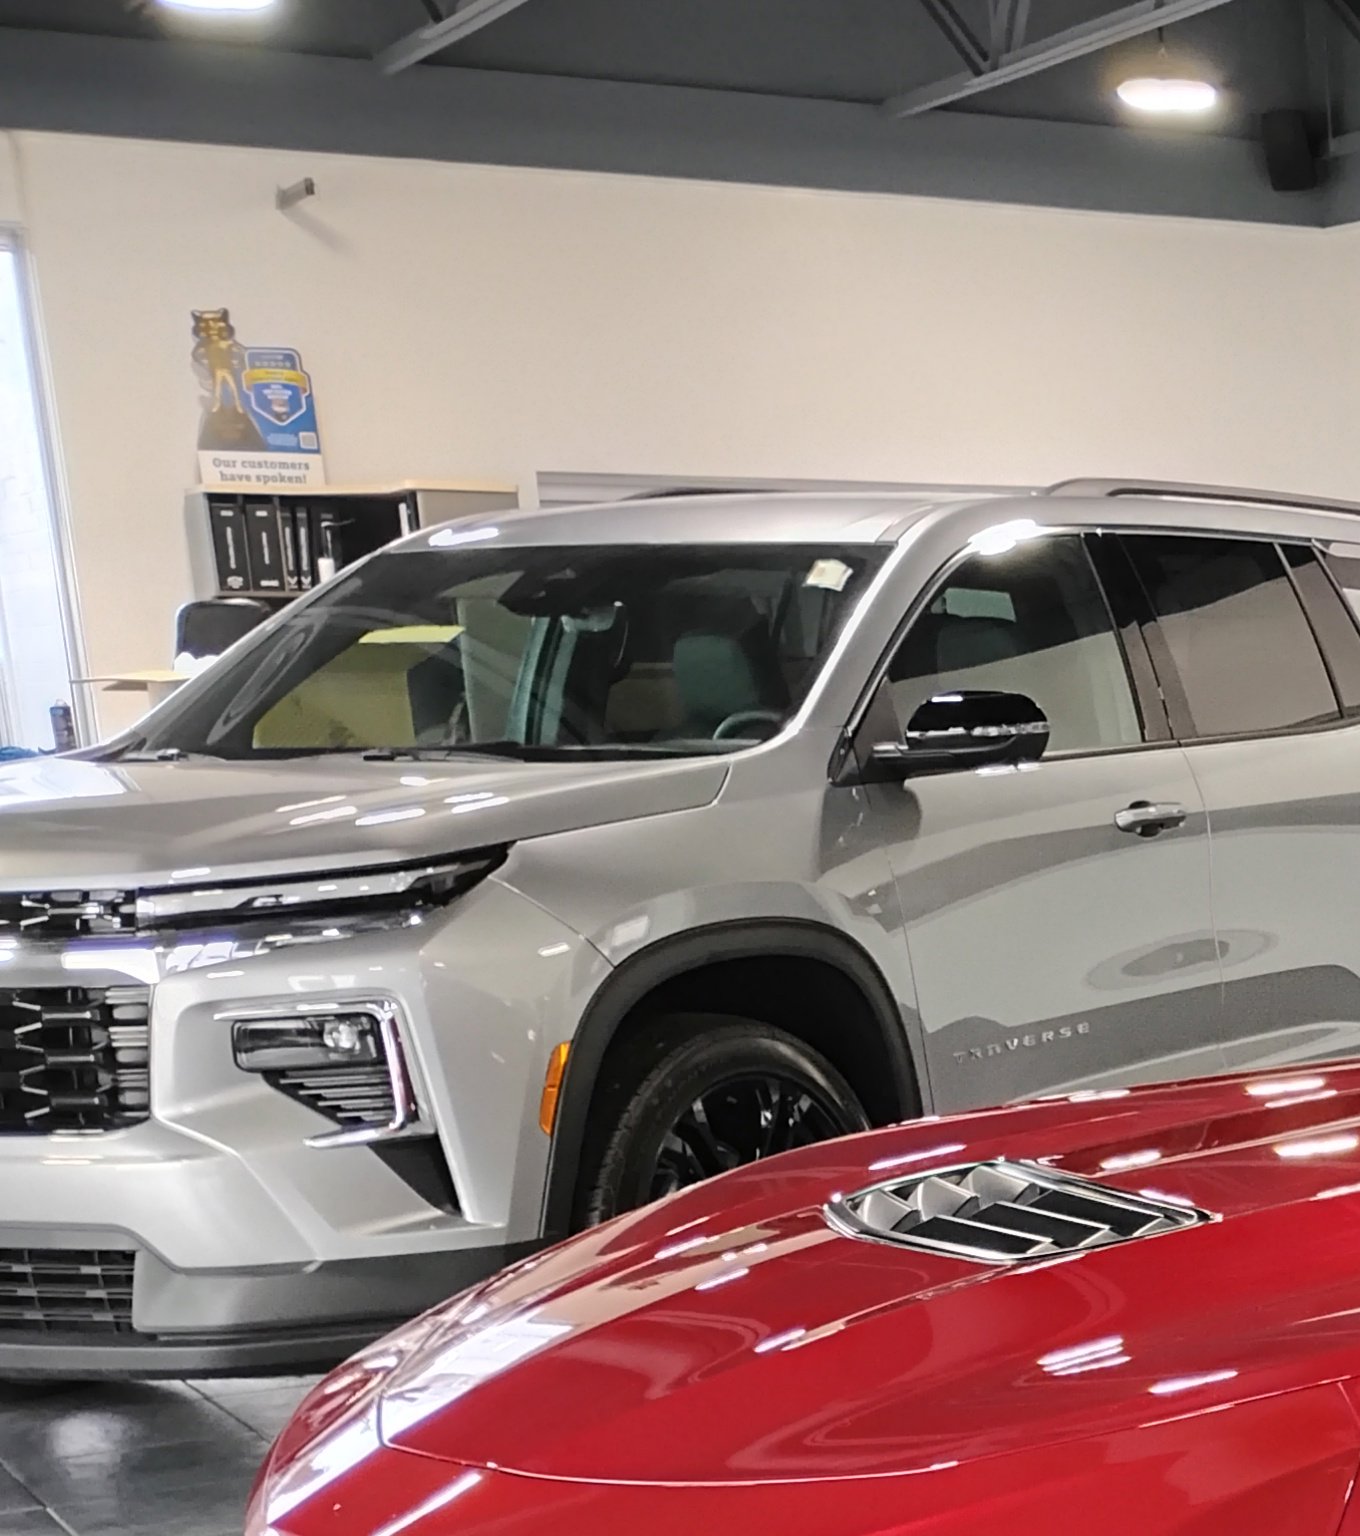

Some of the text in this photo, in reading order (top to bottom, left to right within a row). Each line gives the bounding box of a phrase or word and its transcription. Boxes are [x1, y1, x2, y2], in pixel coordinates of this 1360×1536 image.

[212, 457, 310, 471] Our customers
[219, 471, 307, 485] have spoken!
[952, 1022, 1090, 1063] TRAVERSE
